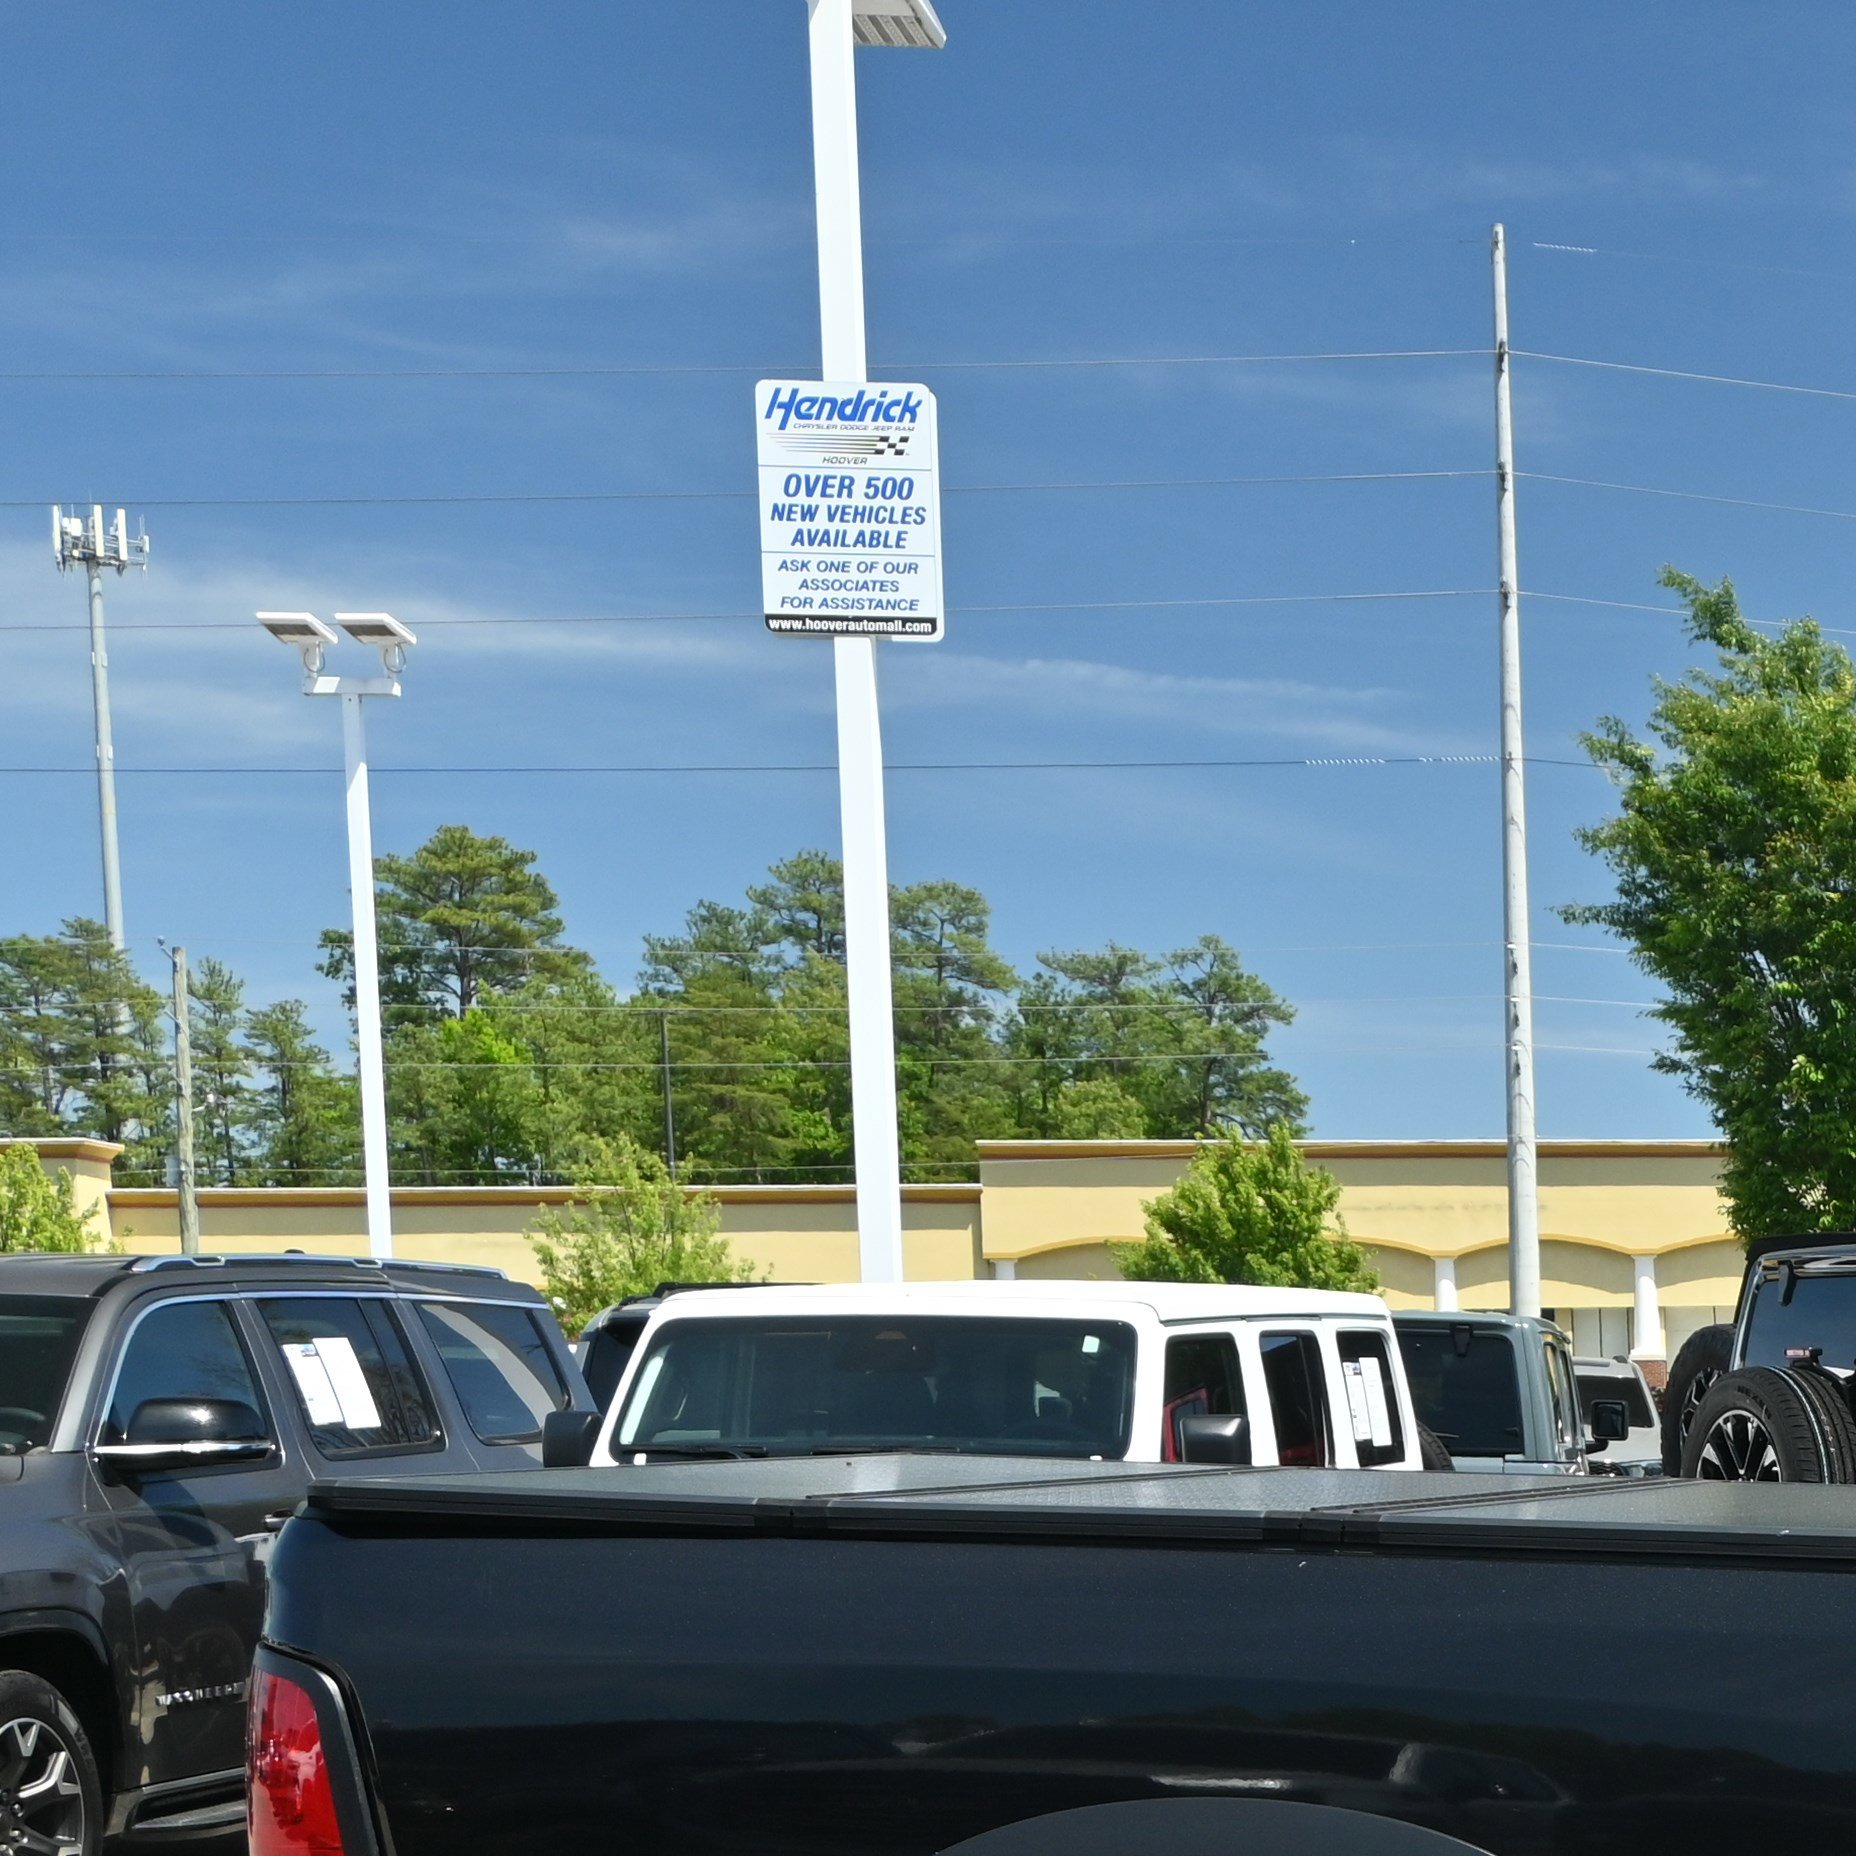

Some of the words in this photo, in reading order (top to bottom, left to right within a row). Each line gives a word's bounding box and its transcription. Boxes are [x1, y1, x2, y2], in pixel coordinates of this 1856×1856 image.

[765, 387, 923, 430] Hendrick
[793, 423, 838, 431] CHRYSLER
[822, 456, 868, 465] HOOVER
[783, 473, 855, 499] OVER
[864, 476, 914, 501] 500
[770, 503, 819, 522] NEW
[826, 505, 927, 525] VEHICLES
[791, 529, 908, 549] AVAILABLE
[778, 559, 811, 572] ASK
[816, 560, 852, 574] ONE
[856, 561, 879, 574] OF
[883, 562, 919, 575] OUR
[799, 579, 900, 592] ASSOCIATES
[780, 596, 814, 609] FOR
[818, 598, 920, 611] ASSISTANCE
[769, 617, 932, 633] www.hooverautomall.com
